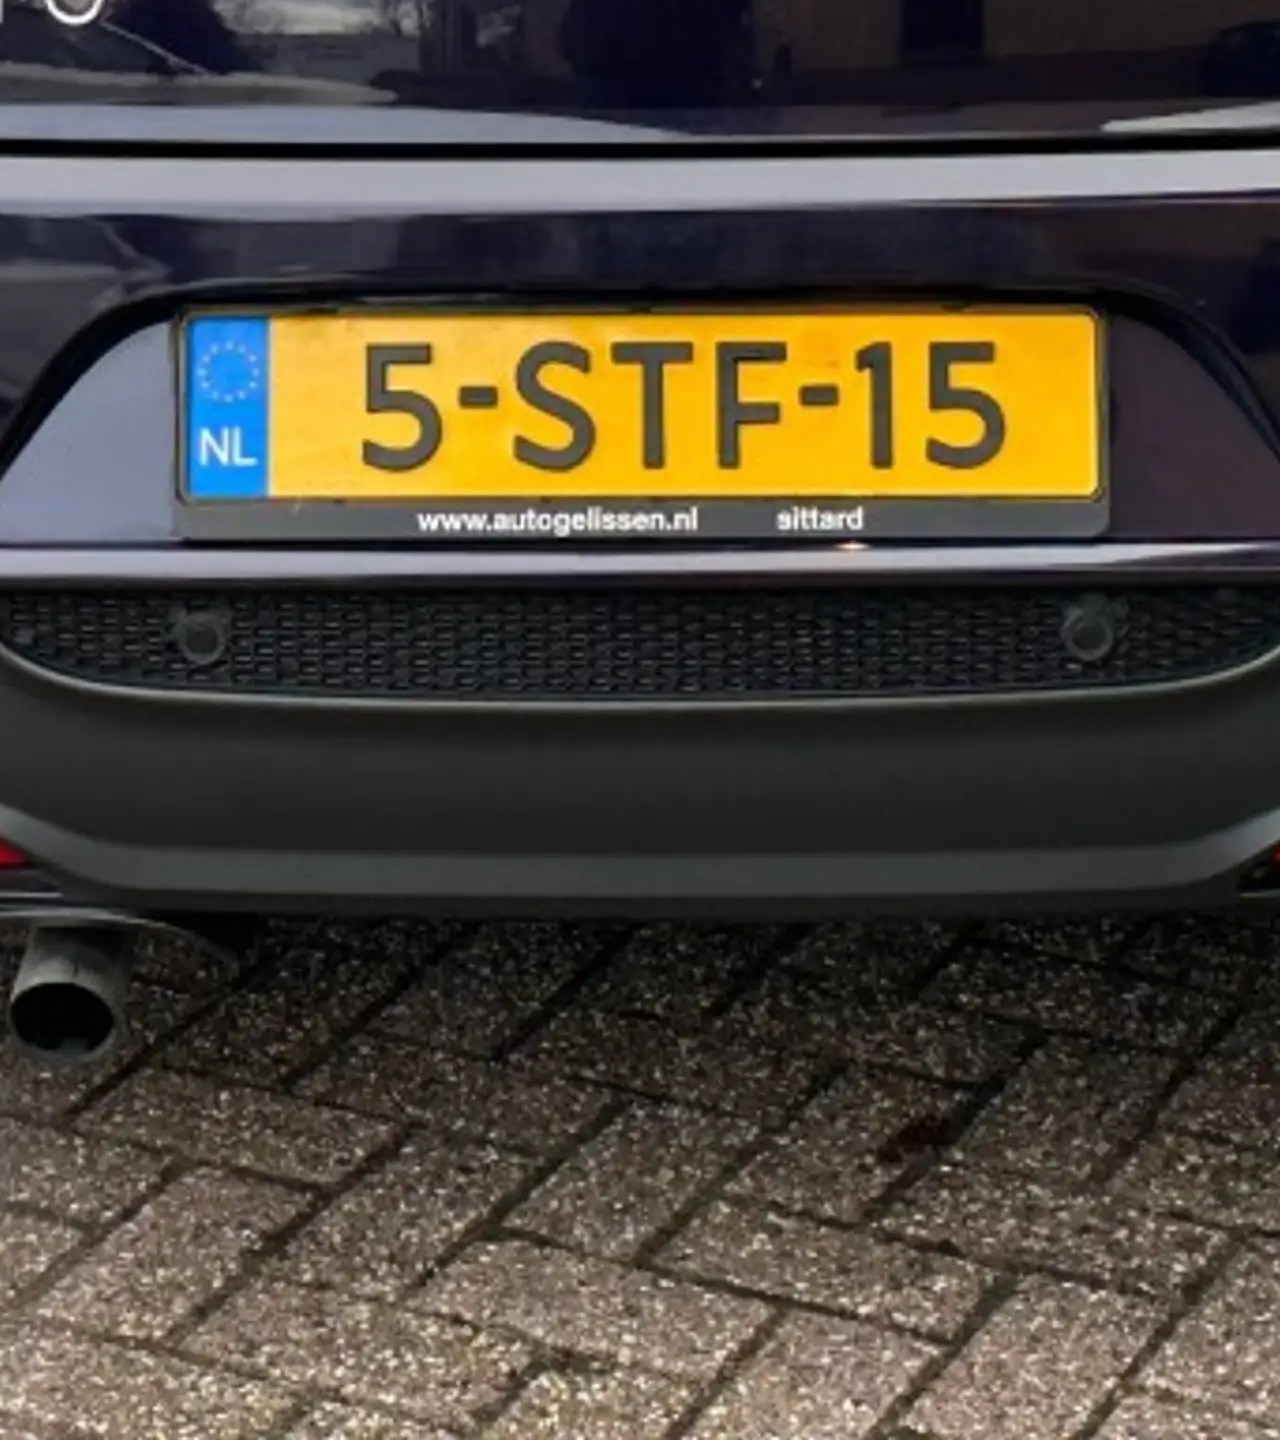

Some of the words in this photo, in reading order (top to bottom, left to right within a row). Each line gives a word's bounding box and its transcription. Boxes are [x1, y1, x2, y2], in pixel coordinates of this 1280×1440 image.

[362, 340, 1006, 472] 5-STF-15
[199, 427, 257, 466] NL
[418, 507, 698, 536] www.autogelissen.nl
[776, 507, 864, 531] sittard
